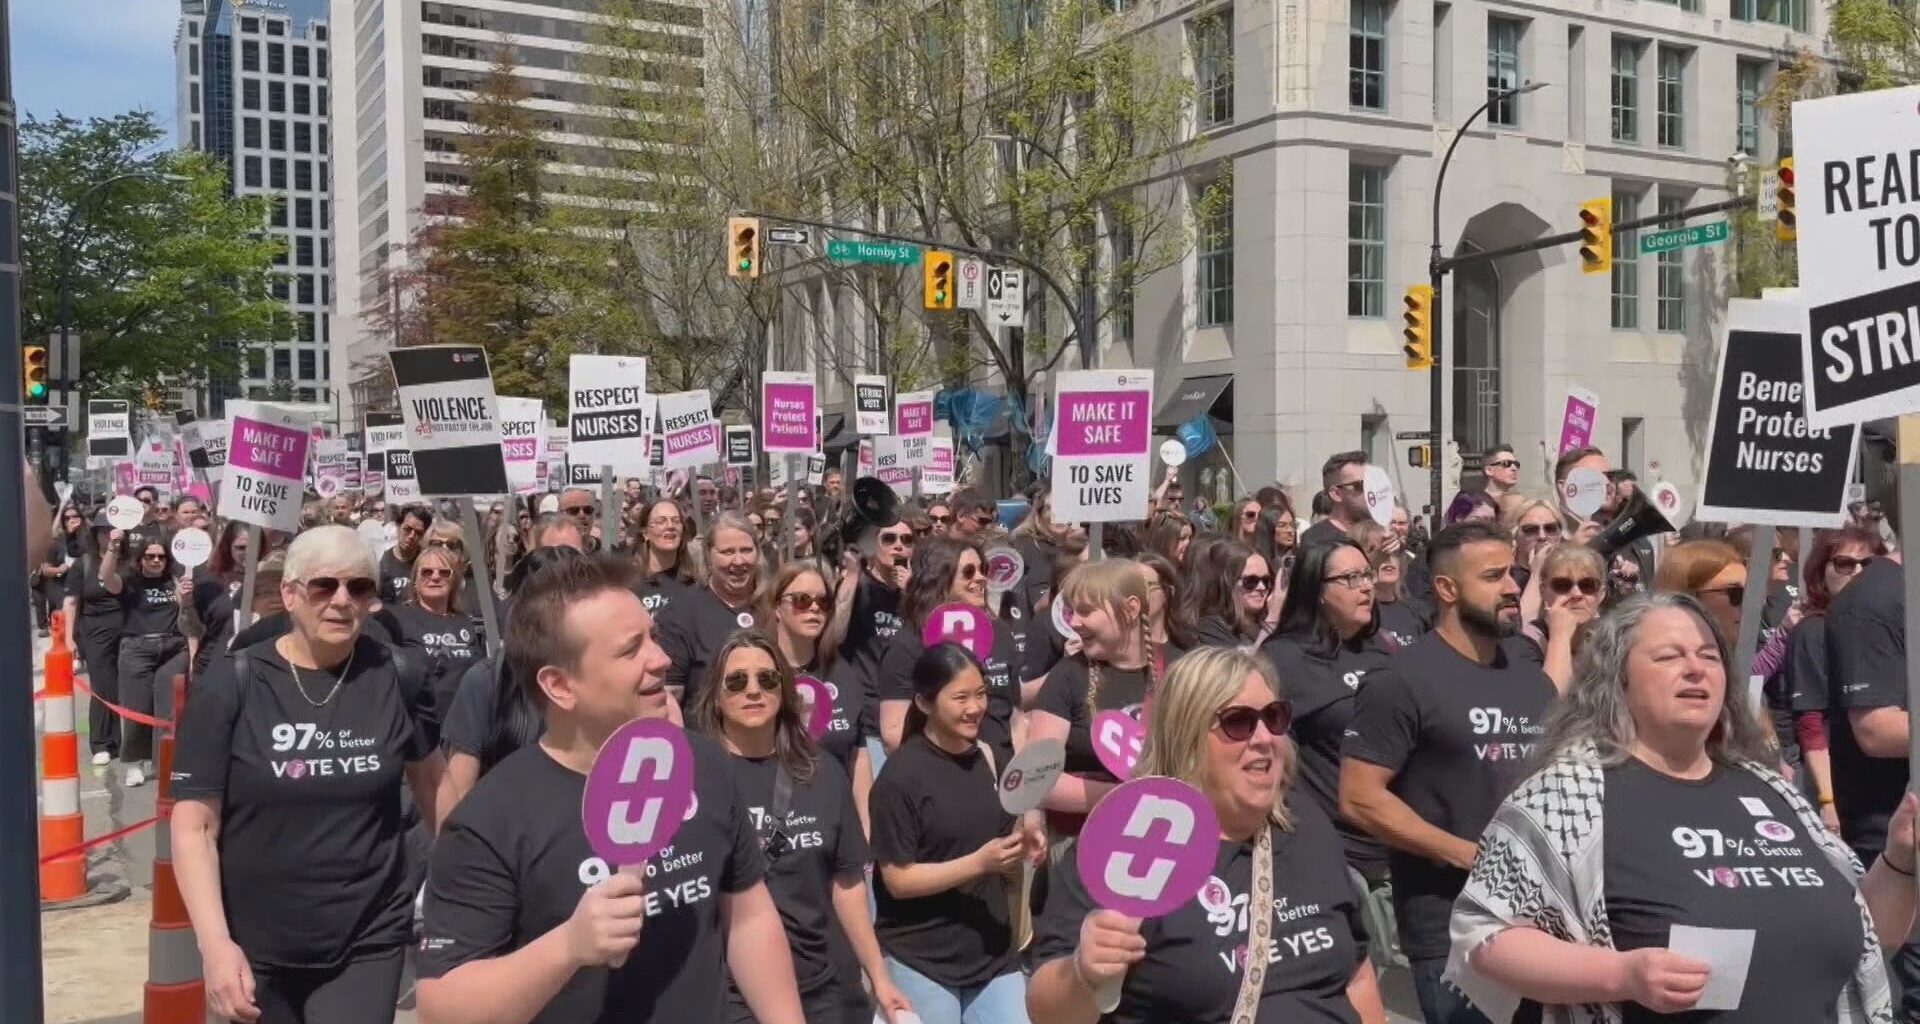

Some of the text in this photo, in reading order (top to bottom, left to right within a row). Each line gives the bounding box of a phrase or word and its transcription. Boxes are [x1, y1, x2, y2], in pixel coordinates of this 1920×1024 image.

[1646, 224, 1721, 249] Georgia St
[1868, 212, 1920, 271] TO
[857, 243, 910, 260] Hornby St
[574, 386, 640, 408] RESPECT
[773, 397, 805, 410] Nurses
[412, 396, 493, 421] VIOLENCE.
[772, 410, 807, 422] Protect
[1072, 401, 1137, 422] MAKE IT
[501, 420, 536, 436] SPECT
[575, 414, 639, 437] NURSES
[664, 409, 709, 431] RESPECT
[770, 423, 809, 435] Patients
[242, 427, 297, 452] MAKE IT
[667, 428, 712, 450] NURSES
[1084, 424, 1123, 444] SAFE
[250, 447, 283, 468] SAFE
[1736, 440, 1824, 474] Nurses
[1069, 463, 1134, 484] TO SAVE
[236, 475, 288, 500] TO SAVE
[391, 485, 410, 496] Yes
[1079, 486, 1122, 506] LIVES
[241, 495, 277, 516] LIVES
[989, 674, 1009, 686] YES
[1468, 706, 1517, 735] 97%
[271, 722, 352, 751] 97% or
[339, 737, 375, 748] better
[1473, 743, 1517, 761] VOTE
[271, 754, 381, 779] VOTE YES
[786, 831, 823, 850] YES
[1671, 826, 1756, 859] 97%
[1759, 845, 1803, 857] better
[659, 845, 674, 858] or
[662, 850, 704, 872] better
[1692, 866, 1825, 889] VOTE YES
[664, 875, 711, 908] YES
[1272, 896, 1288, 908] or
[1277, 903, 1320, 923] better
[1283, 926, 1334, 957] YES
